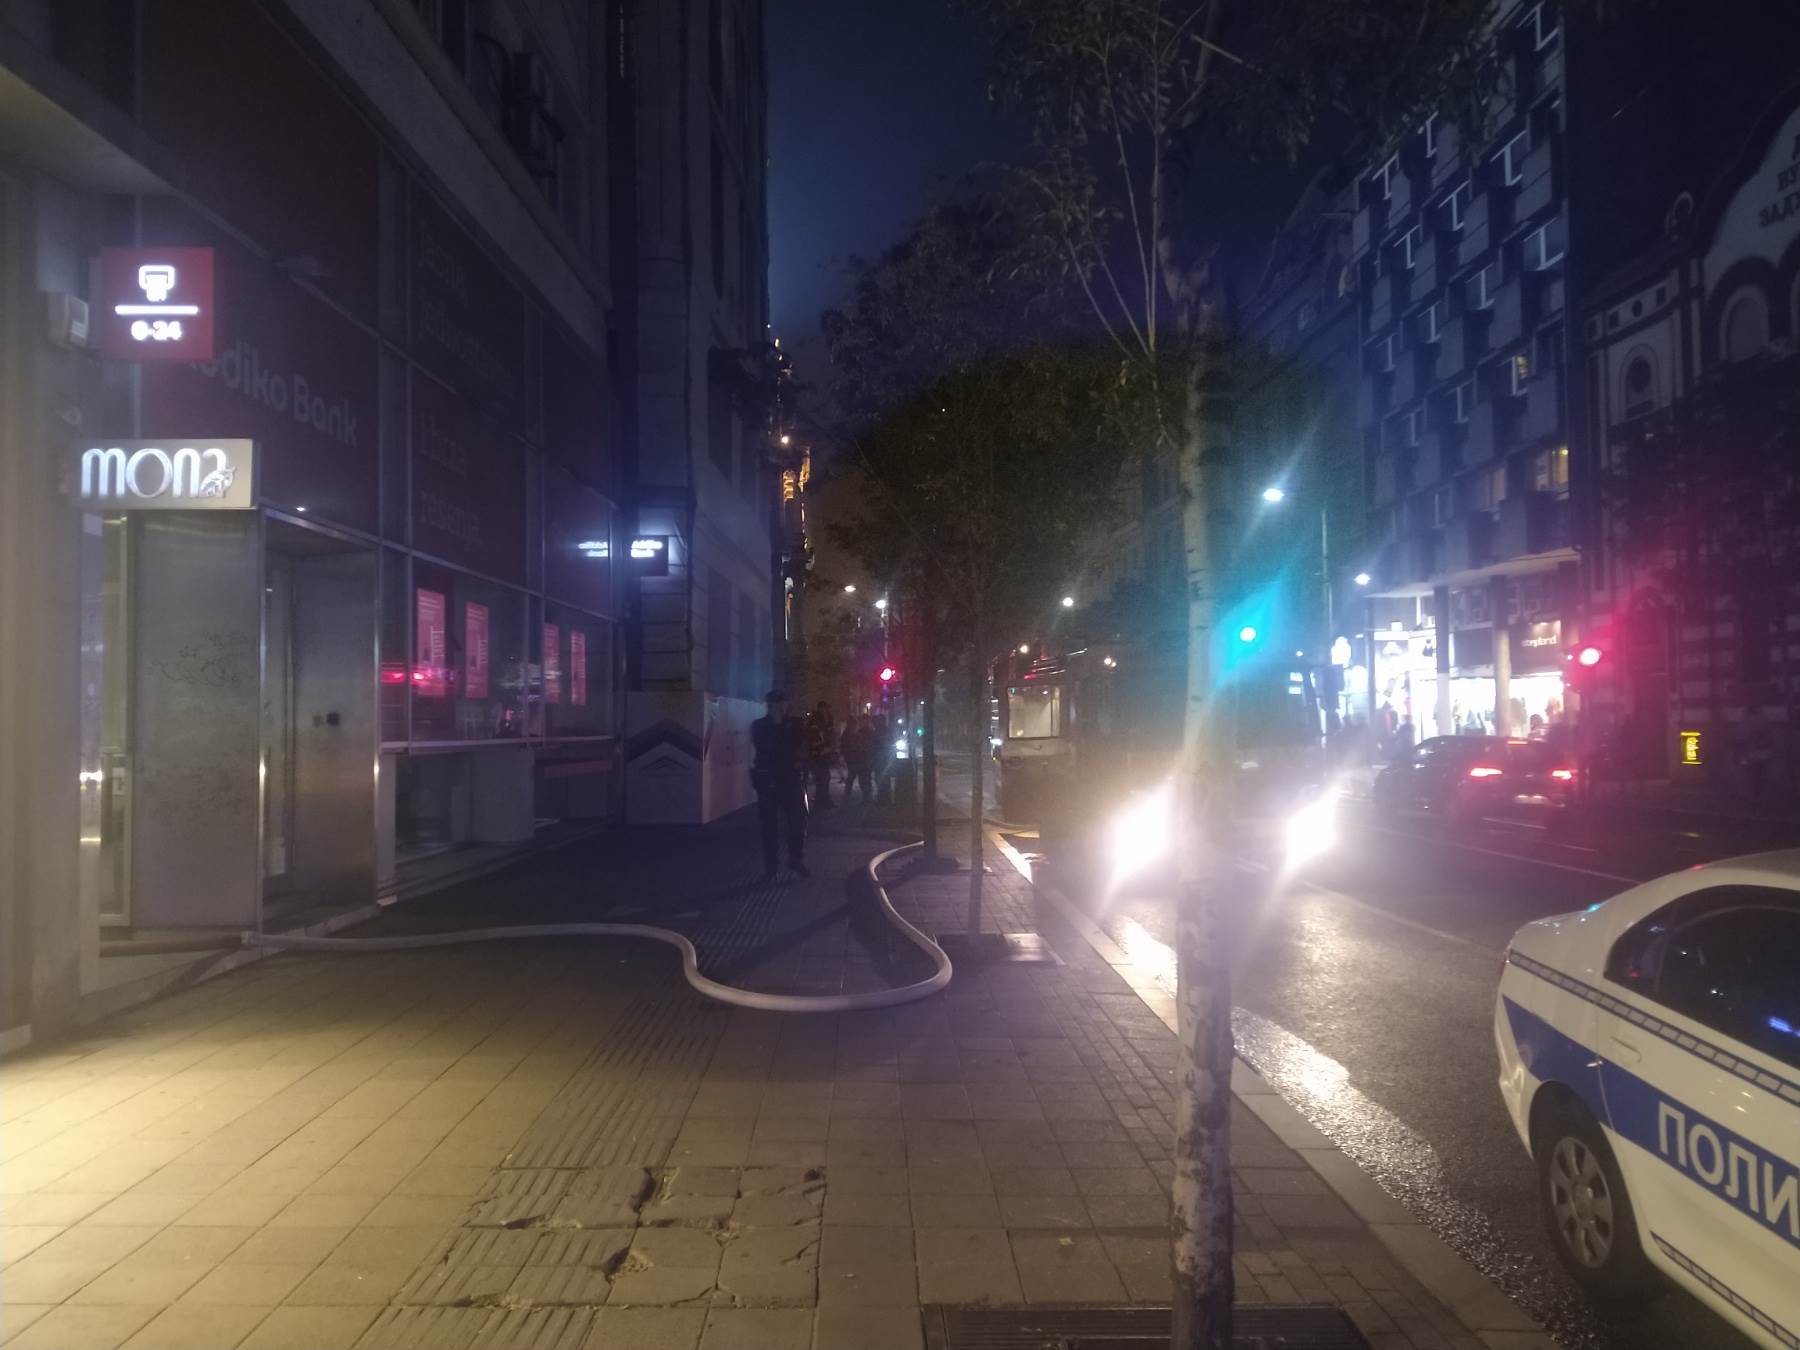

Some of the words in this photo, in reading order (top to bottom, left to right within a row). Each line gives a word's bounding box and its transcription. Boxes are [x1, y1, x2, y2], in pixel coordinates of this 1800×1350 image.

[130, 320, 183, 341] 0-24
[190, 338, 288, 412] diko
[293, 373, 358, 448] Bank
[1658, 1101, 1800, 1241] ПОЛИ
